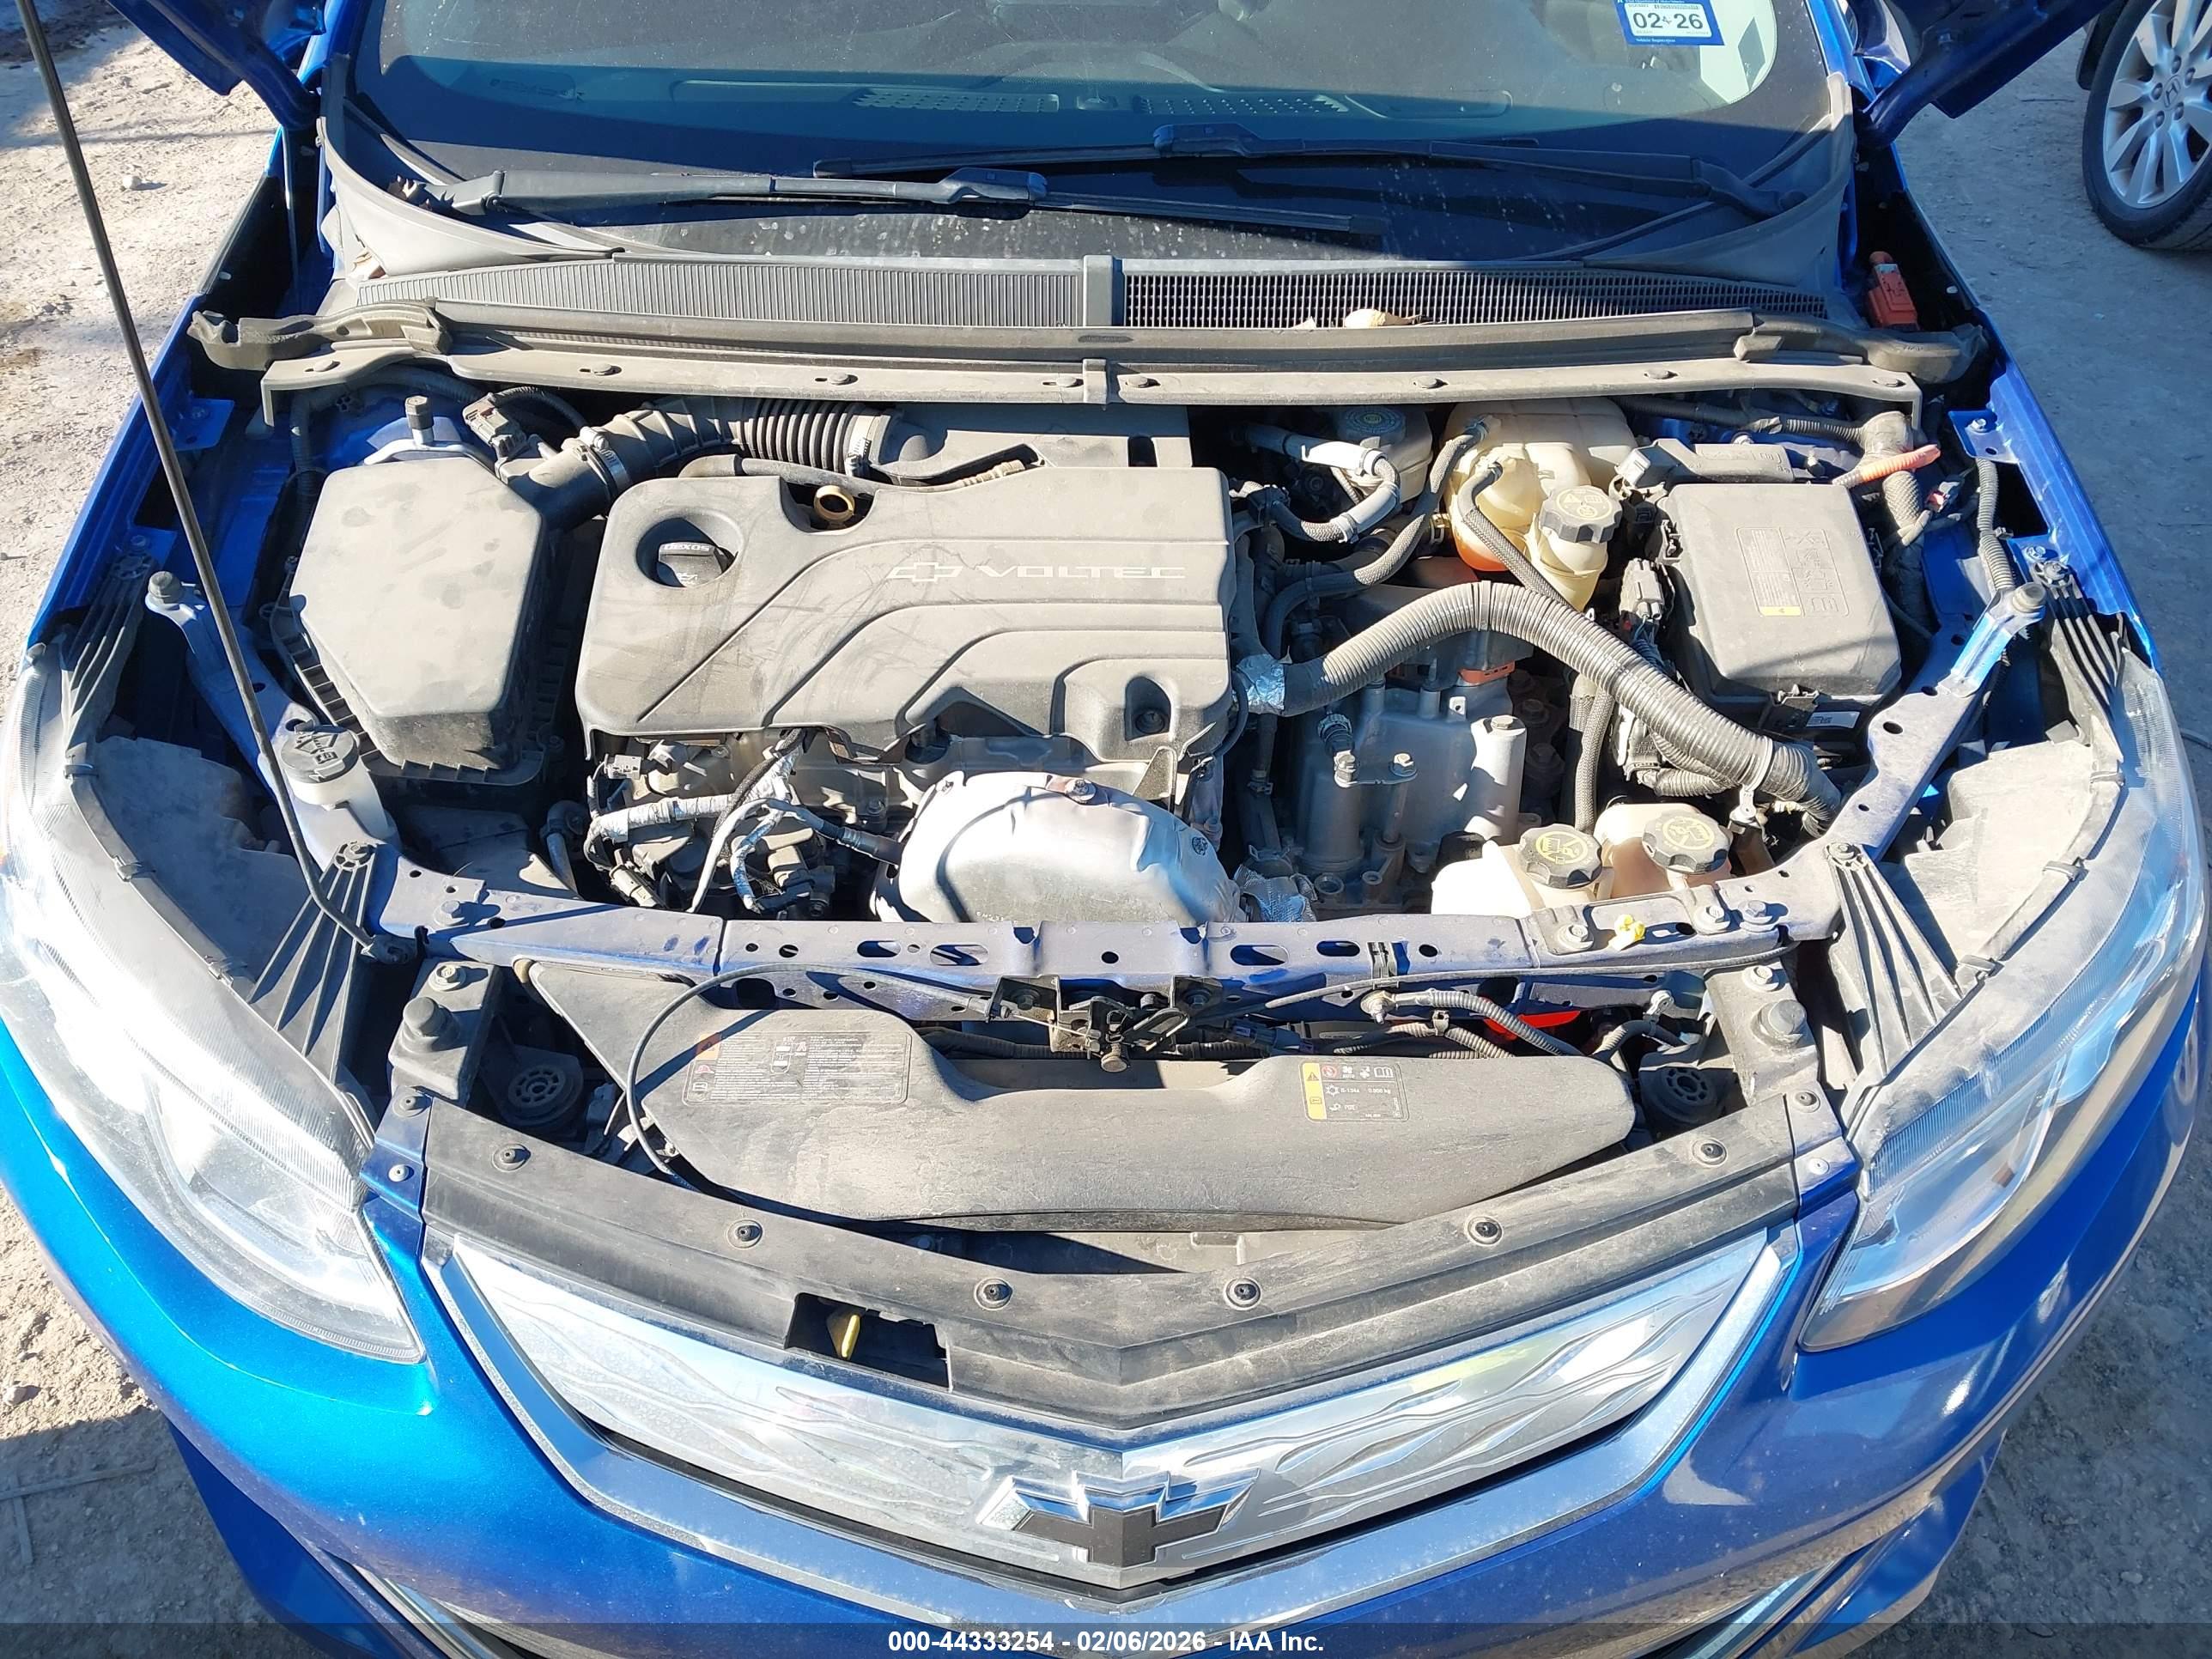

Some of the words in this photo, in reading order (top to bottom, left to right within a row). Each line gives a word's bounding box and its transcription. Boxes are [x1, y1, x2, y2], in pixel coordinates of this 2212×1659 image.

[1632, 12, 1663, 28] 02
[1673, 13, 1704, 29] 26
[975, 565, 1186, 579] VOLTEC
